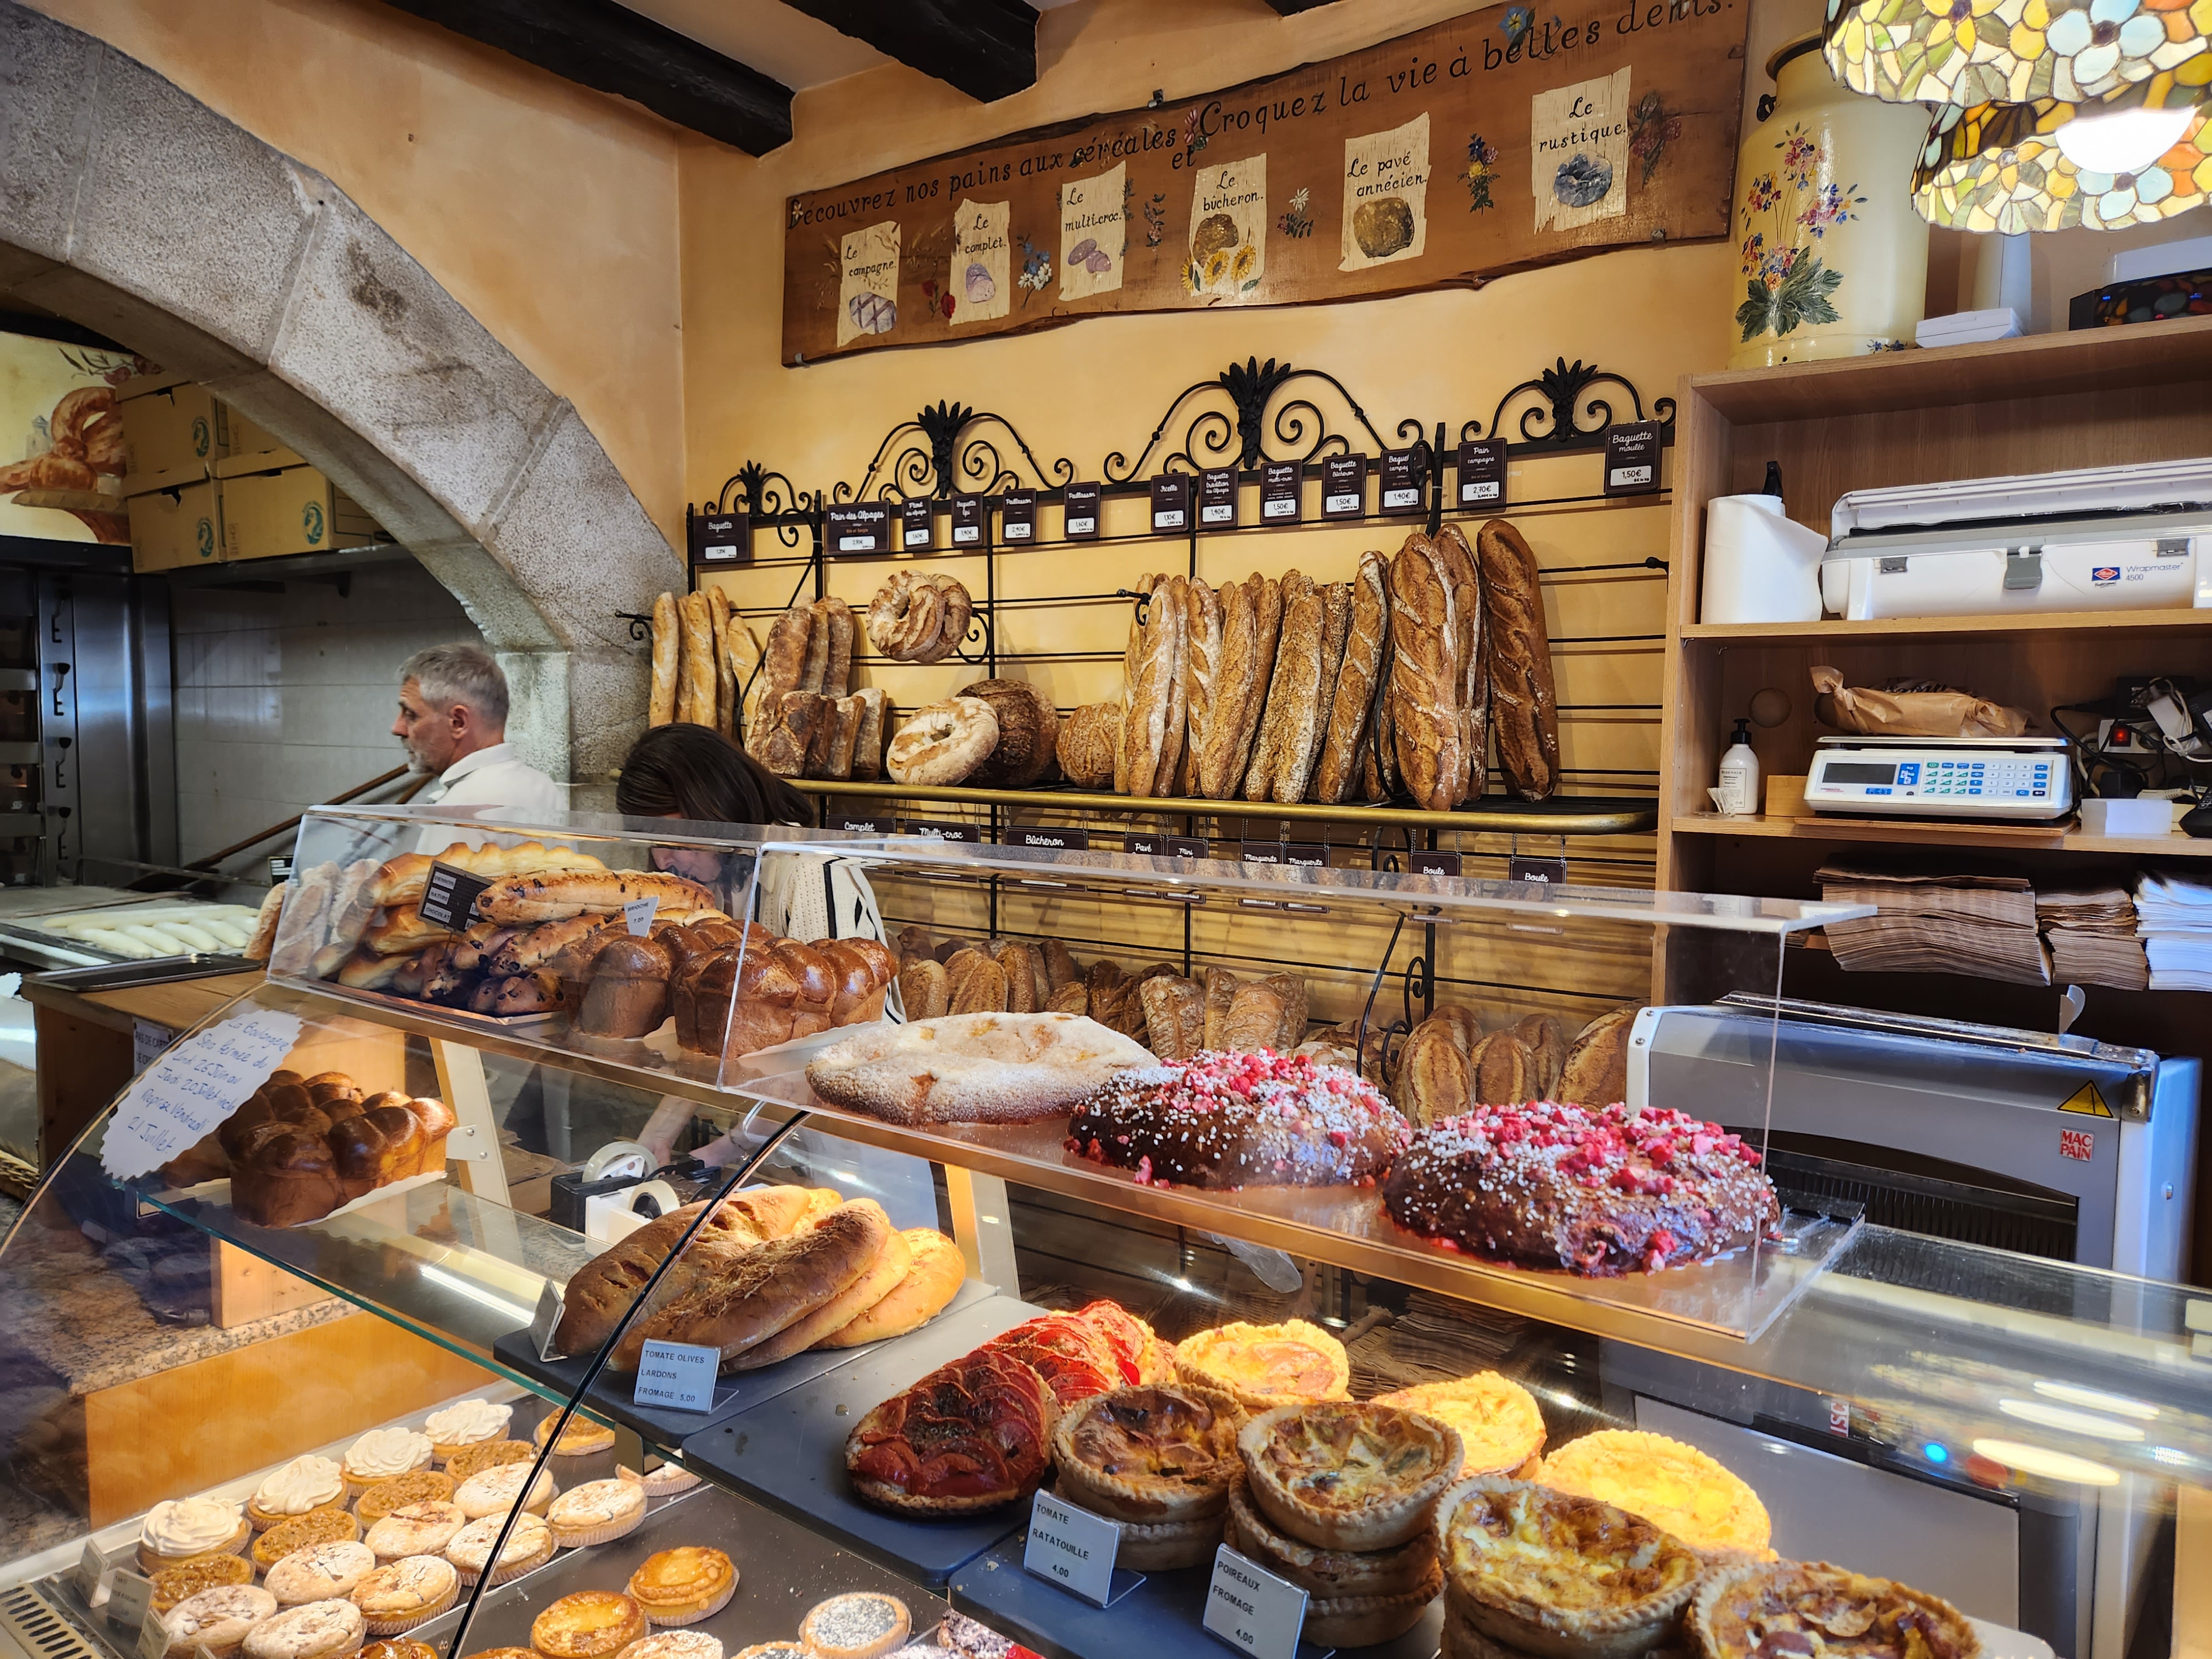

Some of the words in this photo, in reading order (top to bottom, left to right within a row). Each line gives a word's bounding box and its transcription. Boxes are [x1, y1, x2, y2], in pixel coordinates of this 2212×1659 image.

[1199, 92, 1327, 137] Croquez
[1340, 77, 1371, 107] la
[1386, 57, 1438, 93] vie
[1449, 45, 1472, 78] à
[1483, 20, 1601, 71] belles
[1569, 96, 1593, 118] Le
[1540, 122, 1626, 153] rustique.
[1172, 145, 1197, 170] et
[1347, 158, 1368, 178] Le
[1378, 152, 1411, 174] pavé
[787, 189, 896, 229] Découvrez
[906, 179, 940, 204] nos
[949, 161, 1010, 201] pains
[1020, 153, 1063, 177] aux
[1071, 128, 1176, 167] céréales
[1216, 170, 1235, 190] Le
[1357, 173, 1428, 197] annécien.
[1066, 187, 1083, 205] Le
[1203, 191, 1264, 212] bûcheron.
[973, 213, 989, 230] Le
[1065, 211, 1122, 232] multi-croc.
[844, 244, 858, 260] Le
[964, 236, 1006, 255] complet.
[848, 260, 896, 277] campagne.
[1612, 431, 1653, 446] Baguette
[1619, 443, 1645, 452] moulée
[1331, 460, 1357, 471] Baguette
[1467, 456, 1495, 465] campagne
[1207, 472, 1229, 482] Baguette
[1268, 466, 1293, 477] Baguette
[1622, 469, 1641, 479] 1,50€
[1473, 486, 1491, 494] 2,70€
[830, 512, 846, 521] Pain
[846, 512, 857, 520] des
[858, 510, 885, 522] Alpages
[708, 520, 733, 533] Baguette
[2126, 564, 2181, 572] Wrapmaster
[844, 821, 875, 832] Complet
[1025, 834, 1065, 847] Bûcheron
[1135, 843, 1152, 852] Pavé
[1178, 847, 1194, 855] Mini
[1244, 854, 1278, 863] Marguerite
[1288, 857, 1323, 866] Marguerite
[1423, 865, 1445, 876] Boule
[1525, 872, 1549, 883] Boule
[431, 891, 448, 901] NATURE
[426, 907, 450, 919] CHOCOLAT
[628, 902, 649, 911] BRIOCHE
[228, 1016, 243, 1029] La
[135, 1031, 144, 1043] PAS
[145, 1034, 152, 1046] DE
[253, 1056, 269, 1069] du
[194, 1060, 214, 1073] 26
[207, 1063, 229, 1081] Juin
[181, 1079, 198, 1091] 20
[128, 1117, 145, 1134] 21
[2062, 1130, 2092, 1147] MAC
[2060, 1143, 2092, 1161] PAIN
[645, 1350, 674, 1360] TOMATE
[677, 1354, 705, 1364] OLIVES
[641, 1369, 677, 1379] LARDONS
[638, 1387, 675, 1400] FROMAGE
[1036, 1504, 1069, 1525] TOMATE
[1032, 1528, 1089, 1561] RATATOUILLE
[1217, 1561, 1260, 1592] POIREAUX
[1213, 1585, 1254, 1616] FROMAGE
